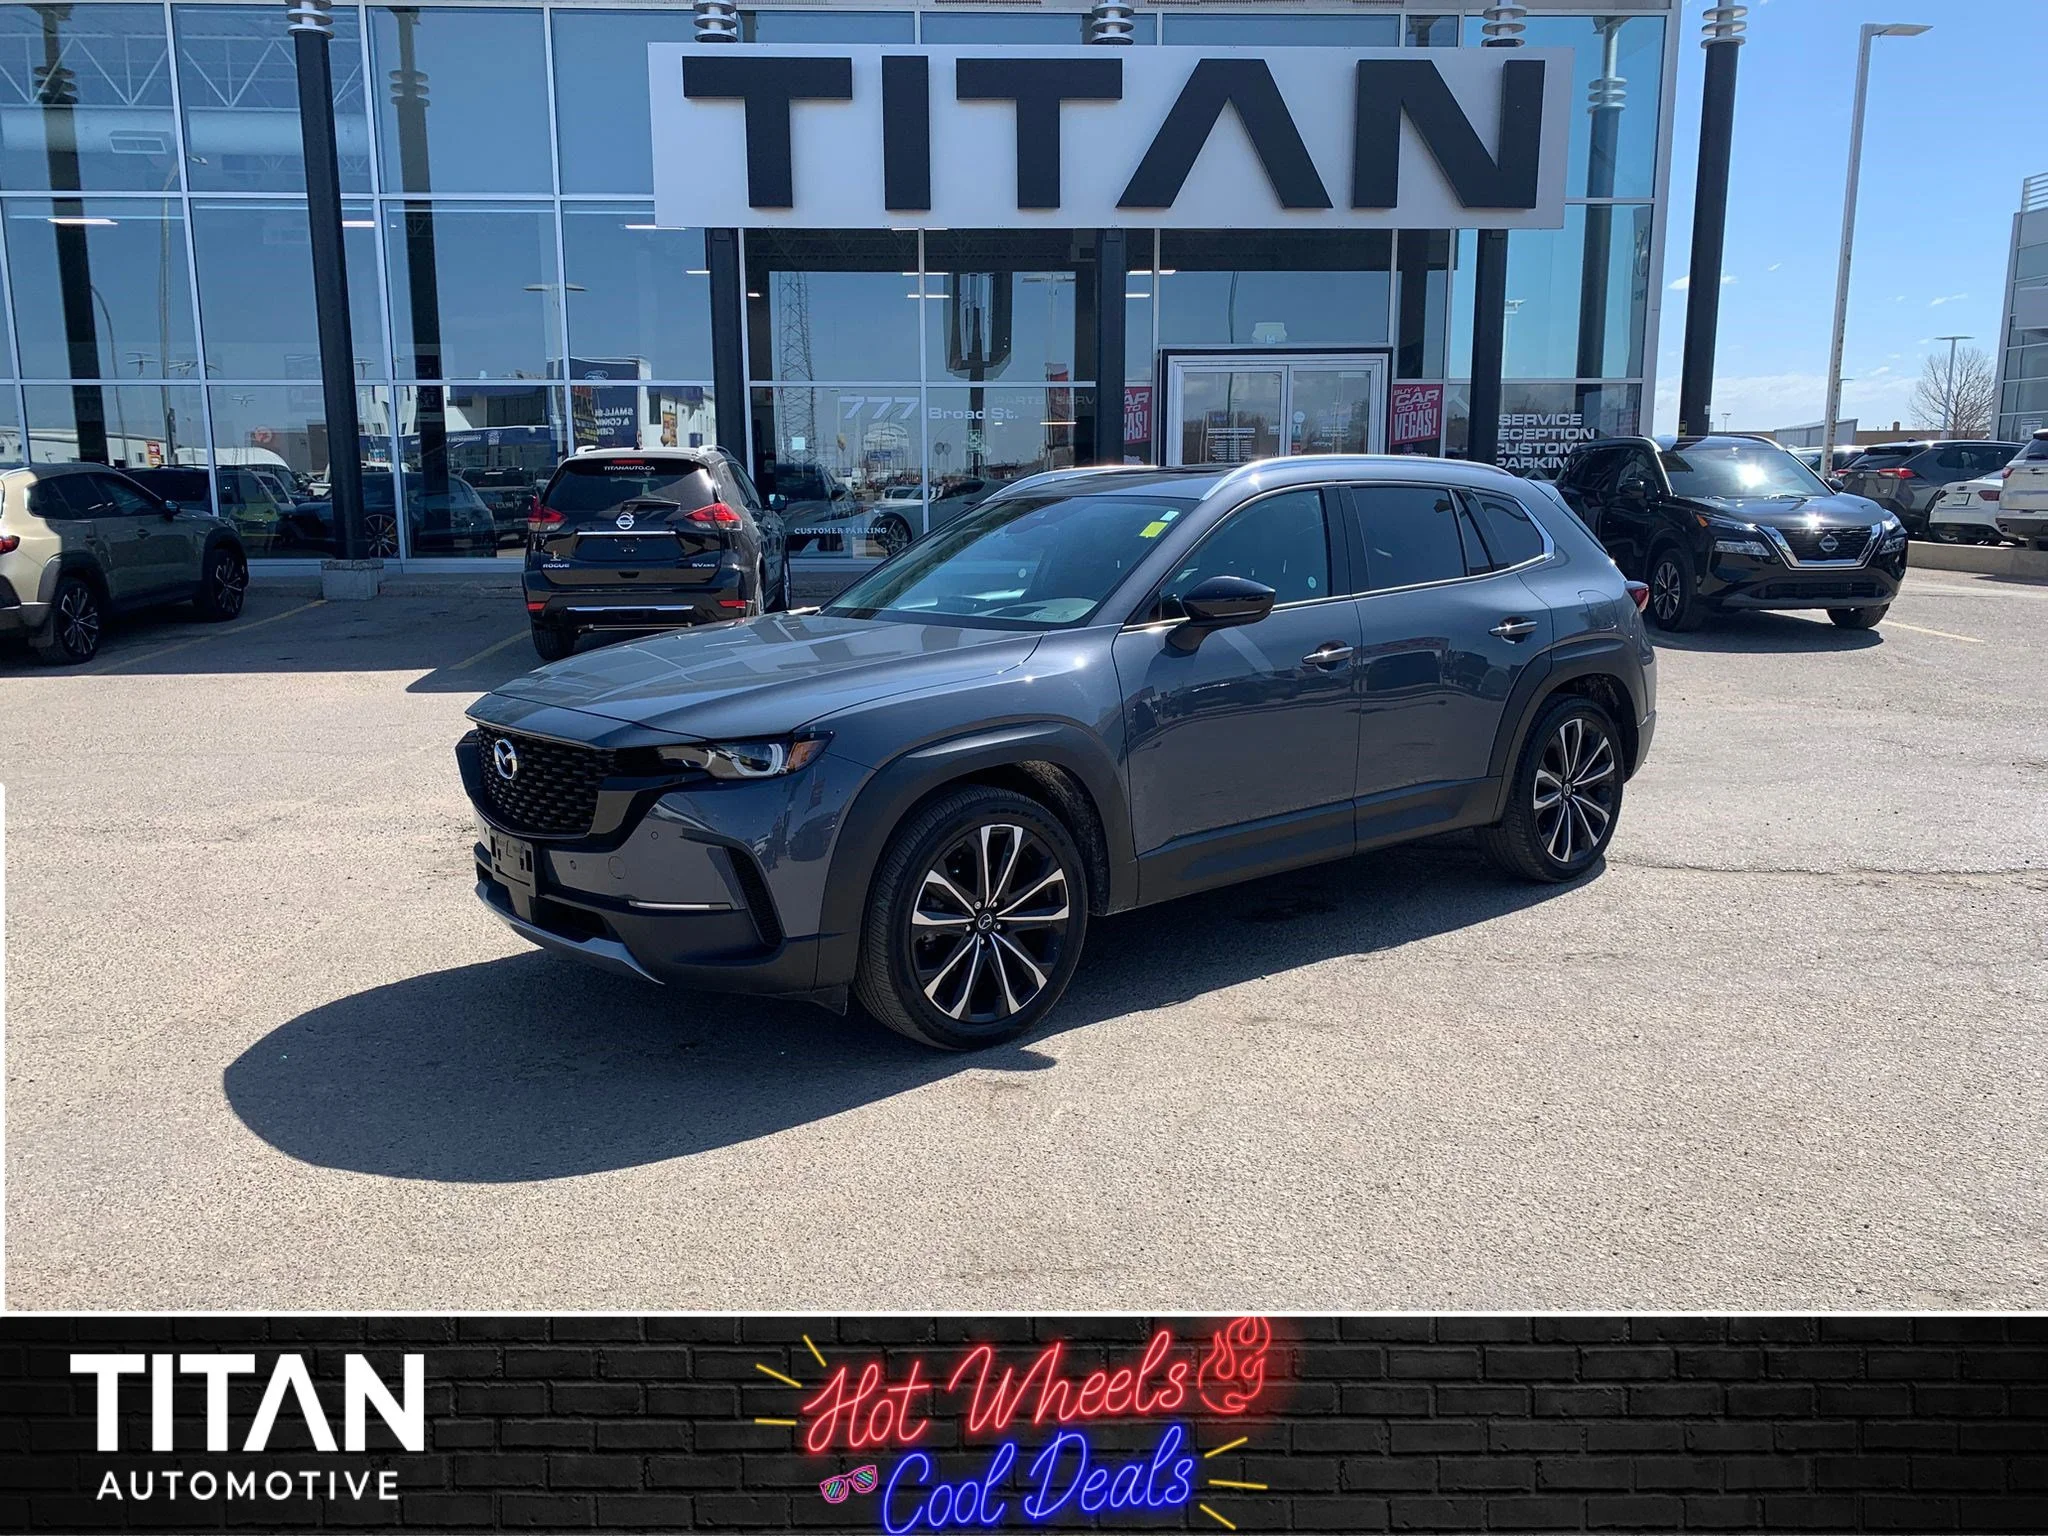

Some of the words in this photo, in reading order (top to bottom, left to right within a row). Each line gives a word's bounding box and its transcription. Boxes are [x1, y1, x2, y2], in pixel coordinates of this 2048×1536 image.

[683, 55, 1546, 210] TITAN
[1394, 387, 1413, 396] BUY
[1056, 395, 1096, 405] SERV
[1124, 392, 1150, 405] AR
[1395, 389, 1440, 407] CAR
[840, 396, 921, 419] 777
[929, 407, 985, 420] Broad
[991, 407, 1019, 420] St.
[1397, 404, 1414, 413] GO
[1416, 402, 1432, 410] TO
[1124, 410, 1148, 440] AS!
[1394, 408, 1437, 440] VEGAS!
[1498, 413, 1582, 426] SERVICE
[1497, 428, 1595, 440] ECEPTION
[1497, 443, 1578, 455] CUSTOM
[1496, 457, 1568, 469] PARKIN
[794, 527, 843, 535] CUSTOMER
